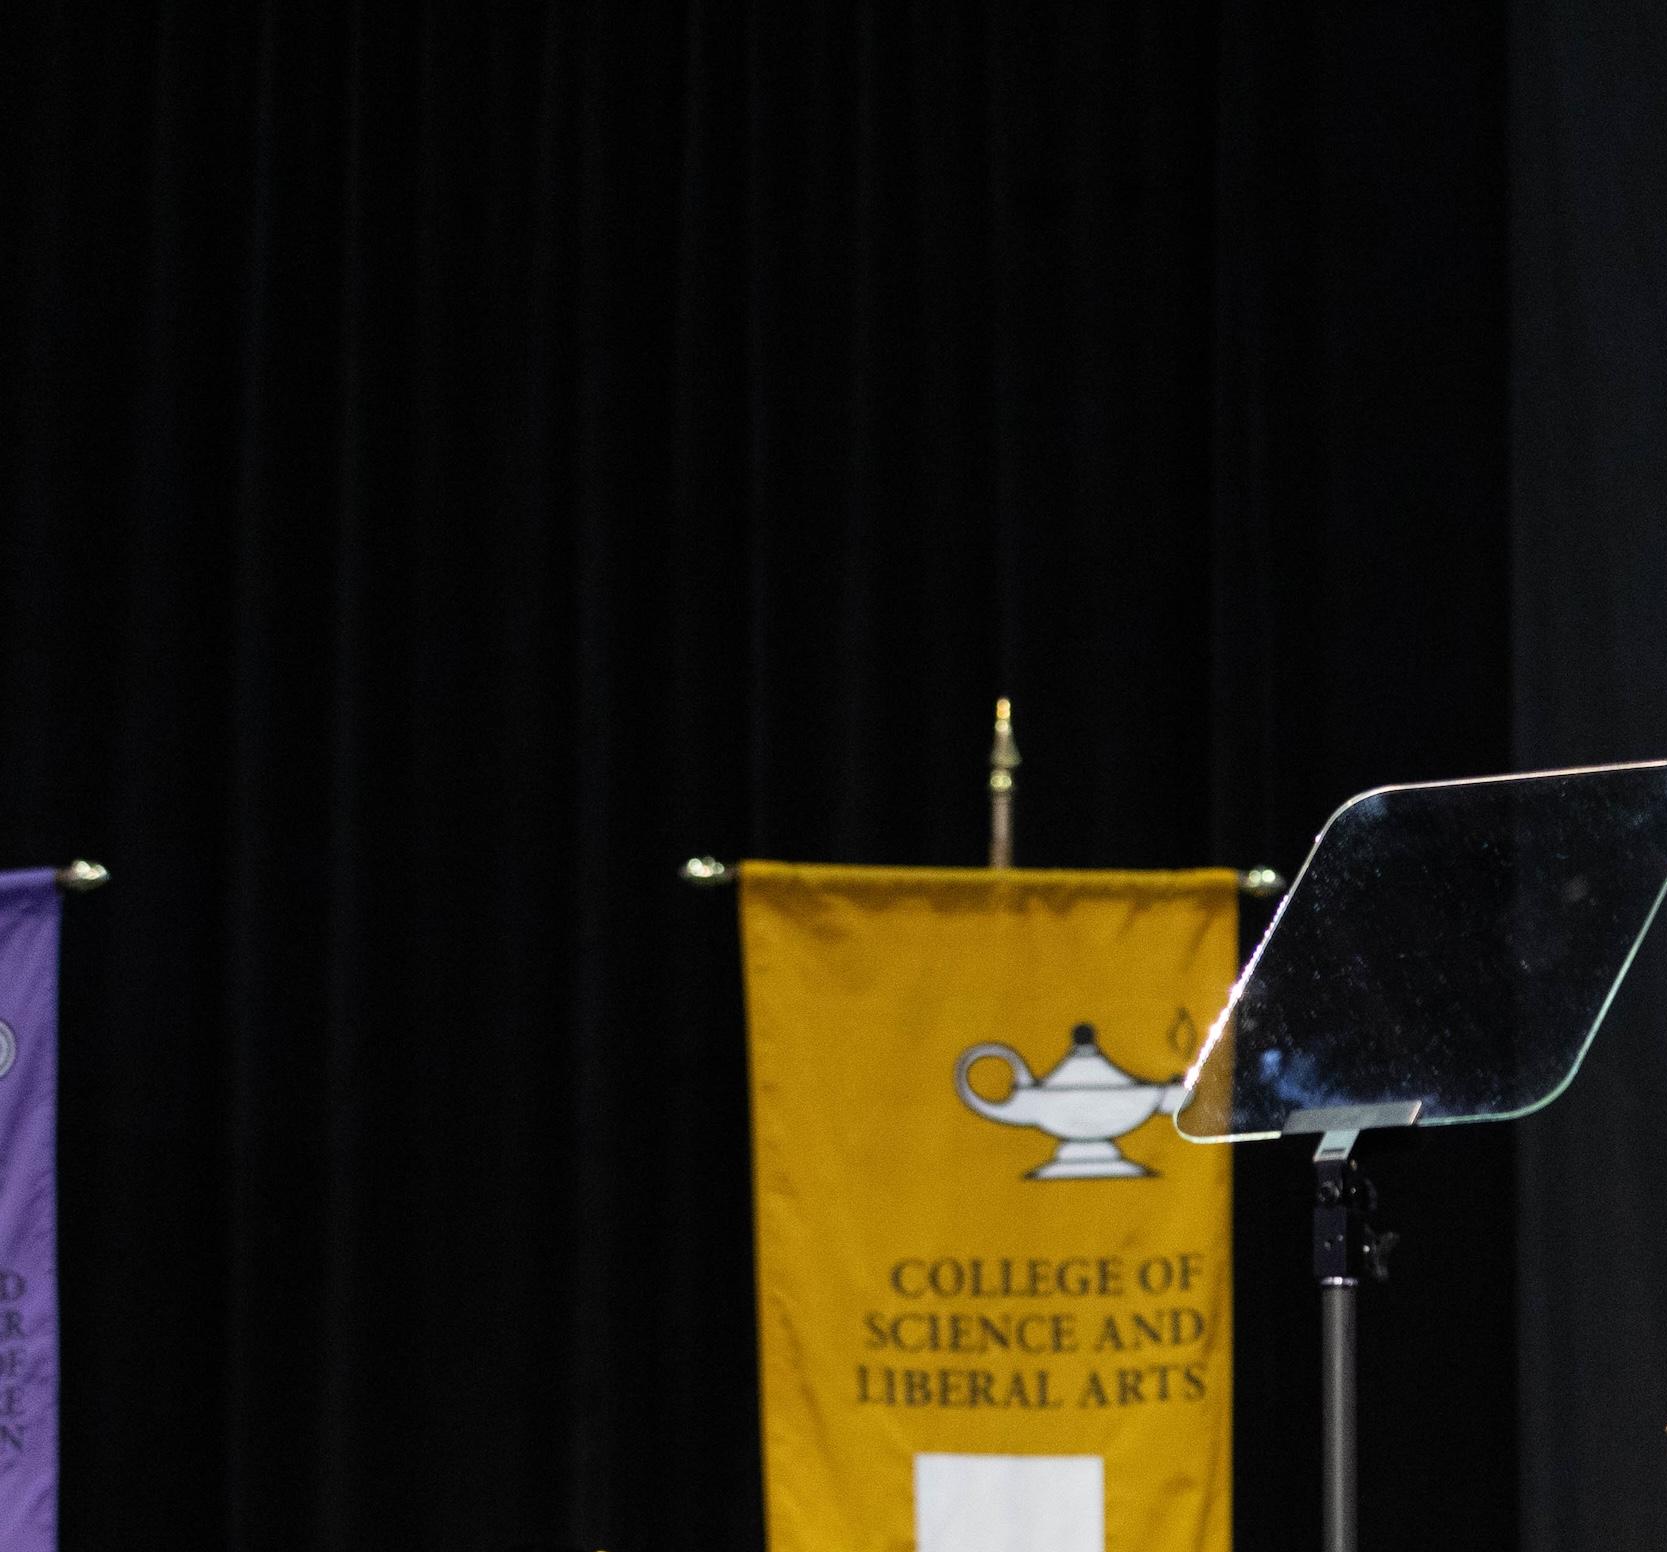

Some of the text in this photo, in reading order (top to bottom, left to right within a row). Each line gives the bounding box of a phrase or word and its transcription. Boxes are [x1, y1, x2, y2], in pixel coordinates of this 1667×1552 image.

[890, 1252, 1205, 1299] COLLEGE OF
[863, 1307, 1204, 1355] SCIENCE AND
[856, 1361, 1209, 1409] LIBERAL ARTS
